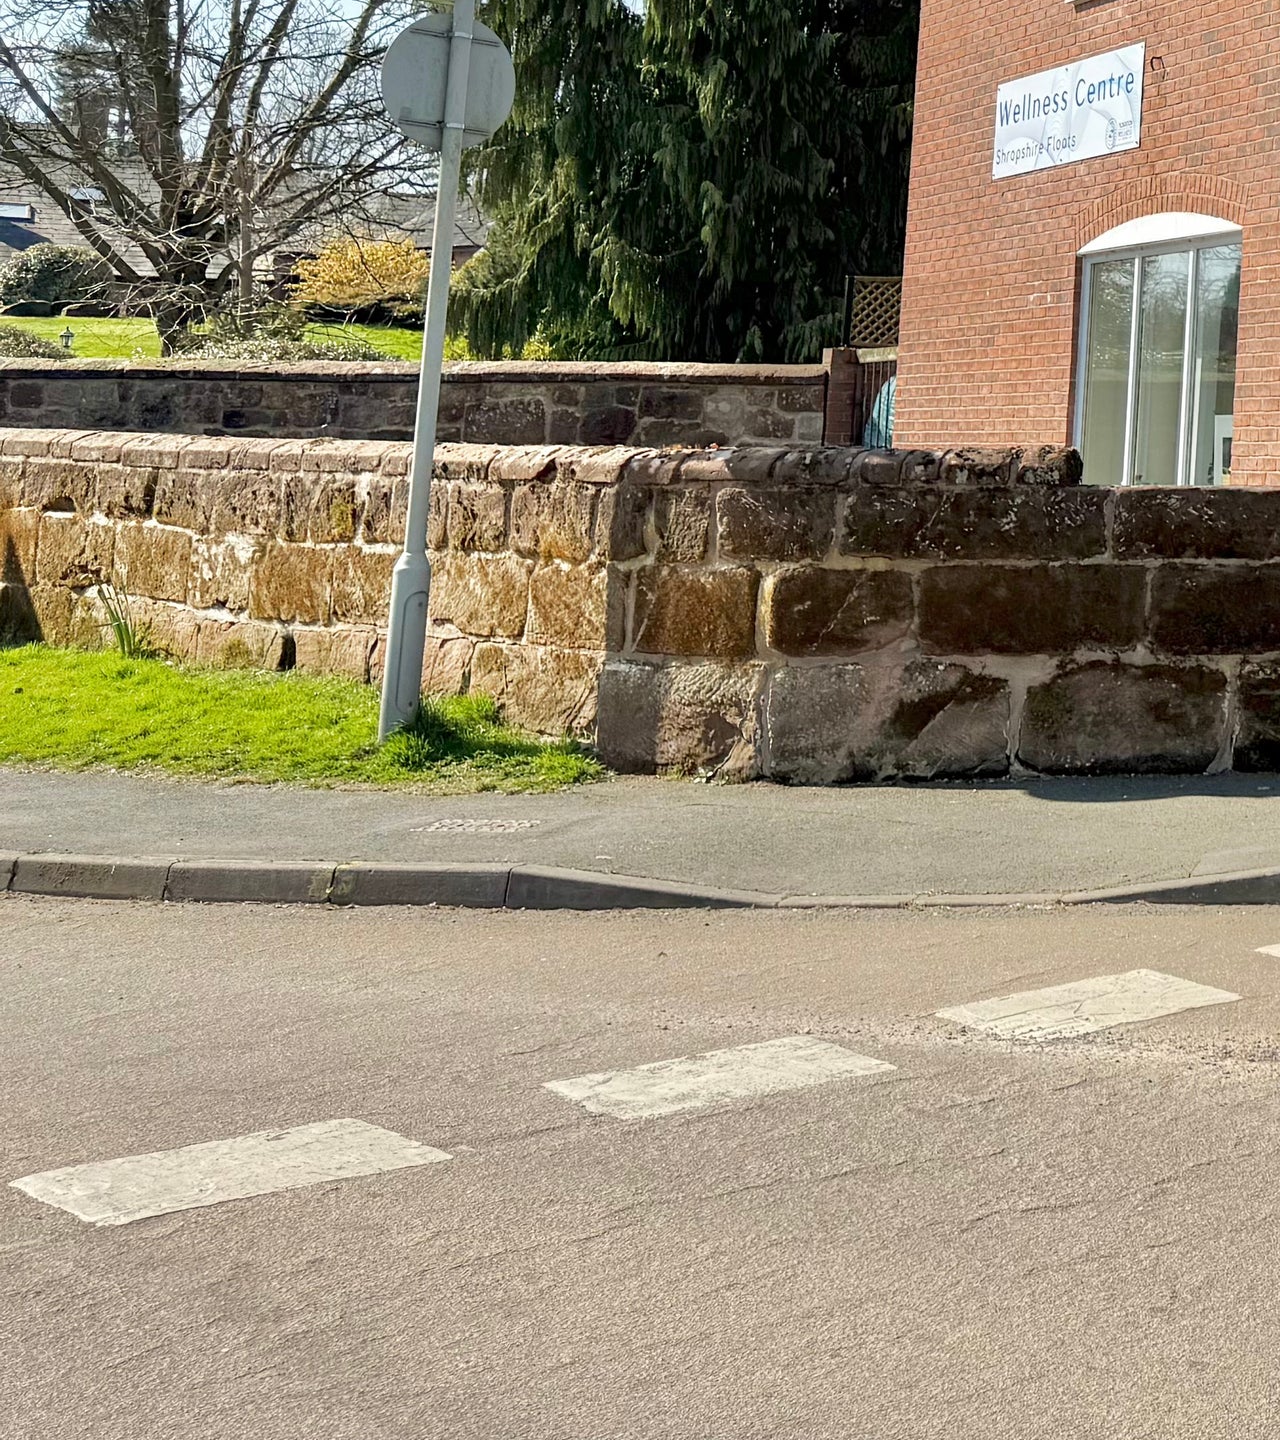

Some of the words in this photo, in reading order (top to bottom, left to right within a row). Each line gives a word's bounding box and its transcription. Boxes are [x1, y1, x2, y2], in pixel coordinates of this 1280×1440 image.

[999, 90, 1069, 128] Wellness
[1075, 71, 1135, 106] Centre
[995, 141, 1044, 165] Shropshire
[1046, 133, 1077, 153] Floats
